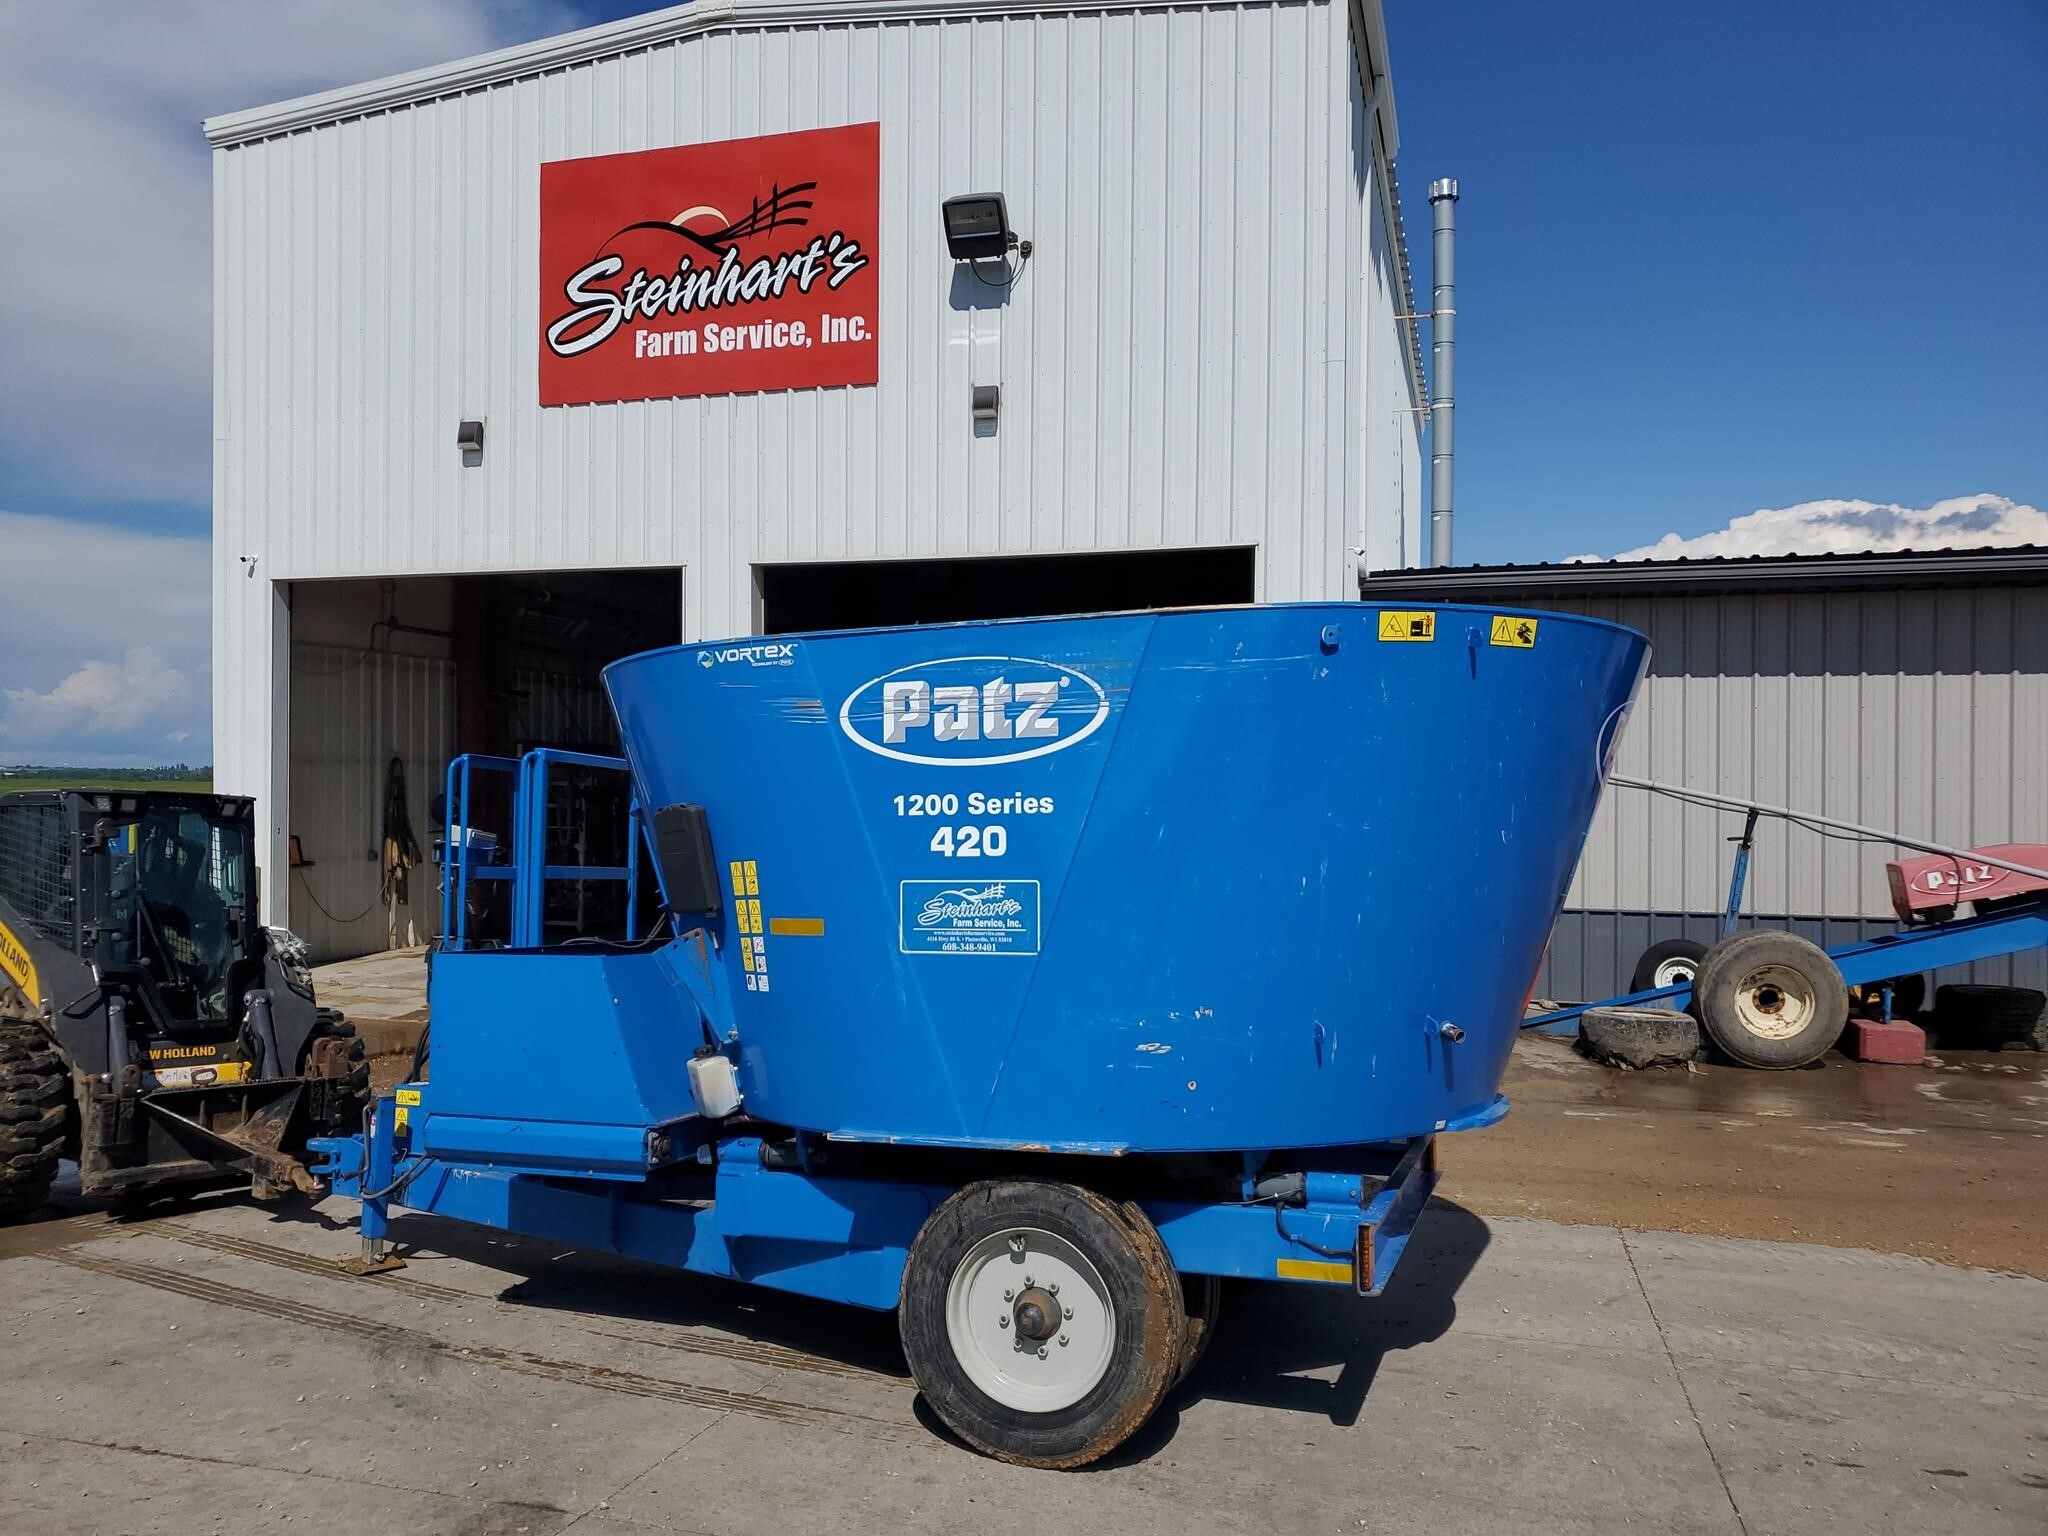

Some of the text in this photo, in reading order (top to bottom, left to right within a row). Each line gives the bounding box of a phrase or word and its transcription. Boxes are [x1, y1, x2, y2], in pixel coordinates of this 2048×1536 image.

[546, 233, 868, 356] Steinhart's
[635, 314, 872, 359] Farm Service, Inc.
[893, 791, 1055, 816] 1200 Series
[930, 826, 1008, 858] 420
[917, 898, 1022, 926] Steinhart's
[953, 918, 1022, 929] Farm Service, Inc.
[942, 942, 996, 951] 608-348-9401
[163, 1046, 217, 1059] HOLLAND
